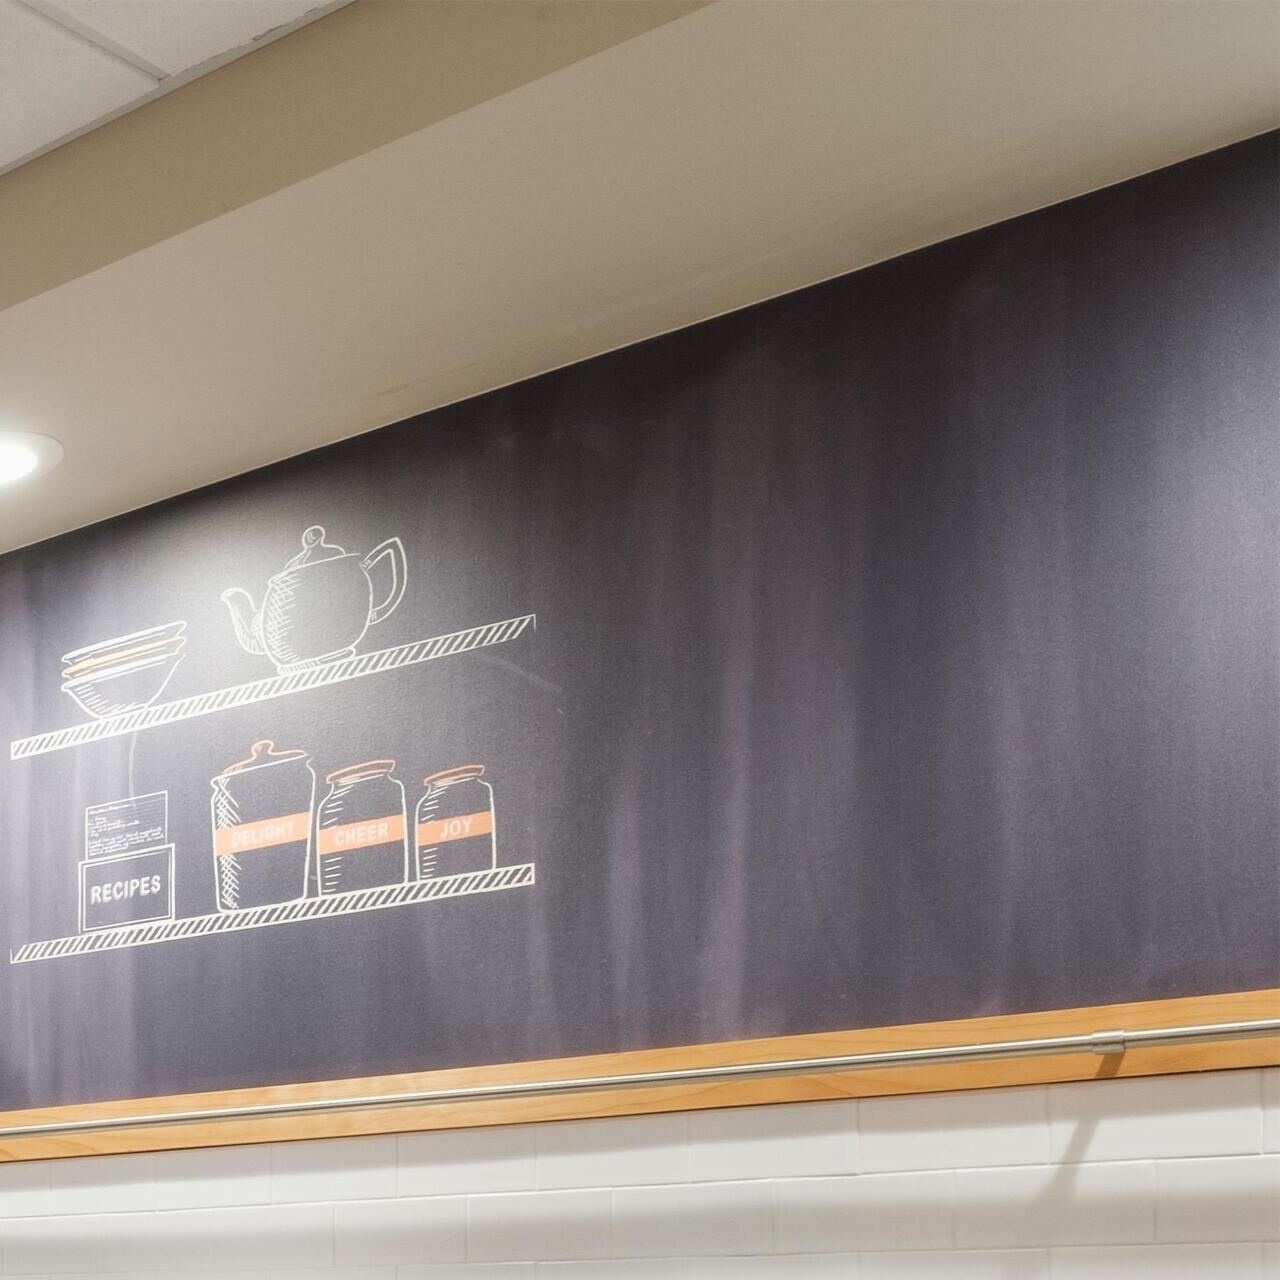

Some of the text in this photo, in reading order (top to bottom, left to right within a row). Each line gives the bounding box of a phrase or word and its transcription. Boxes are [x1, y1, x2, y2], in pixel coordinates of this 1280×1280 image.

[231, 821, 295, 846] DELIGHT
[335, 822, 389, 845] CHEER
[440, 818, 473, 839] JOY
[90, 875, 161, 905] RECIPES
